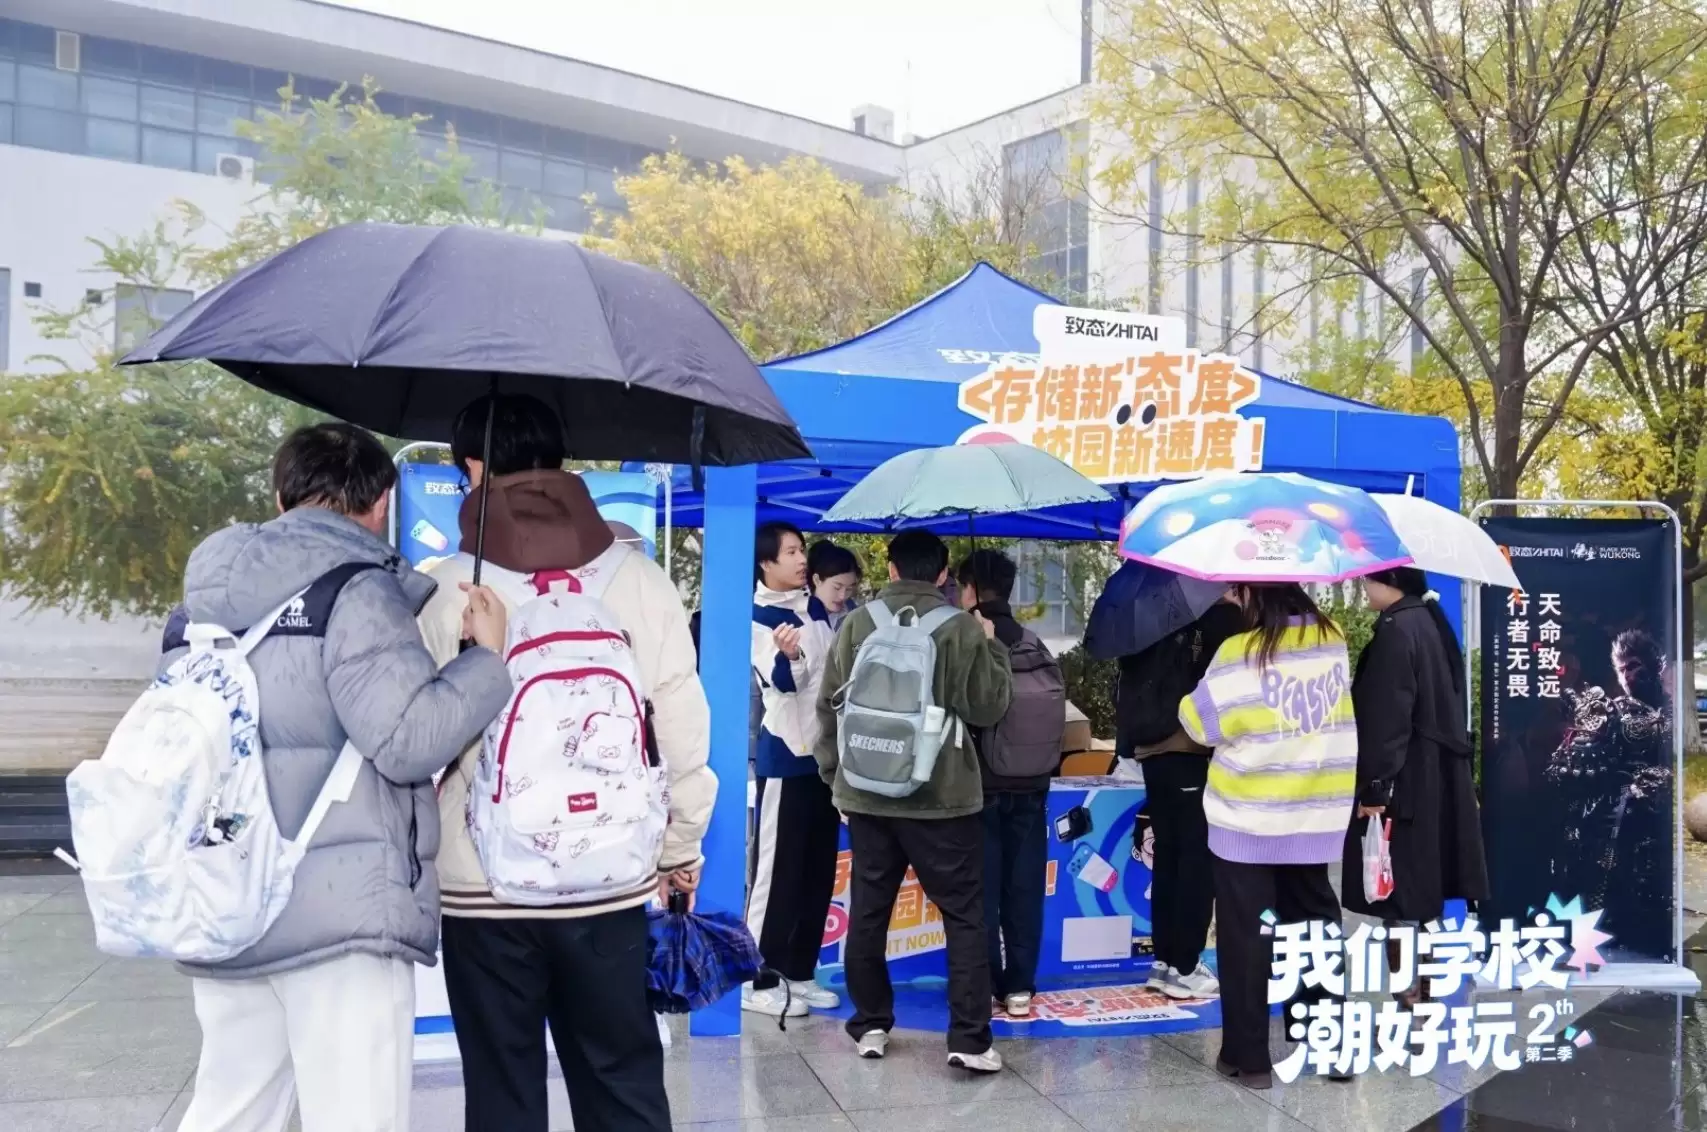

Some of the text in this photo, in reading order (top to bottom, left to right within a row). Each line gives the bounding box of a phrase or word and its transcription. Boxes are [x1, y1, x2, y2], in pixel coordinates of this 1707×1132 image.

[1600, 552, 1641, 560] WUKONG
[277, 616, 312, 628] CAMEL
[1507, 593, 1531, 698] 行者无畏
[1261, 662, 1345, 734] BEASTER
[848, 733, 905, 755] SKECHERS
[906, 932, 944, 951] NOW
